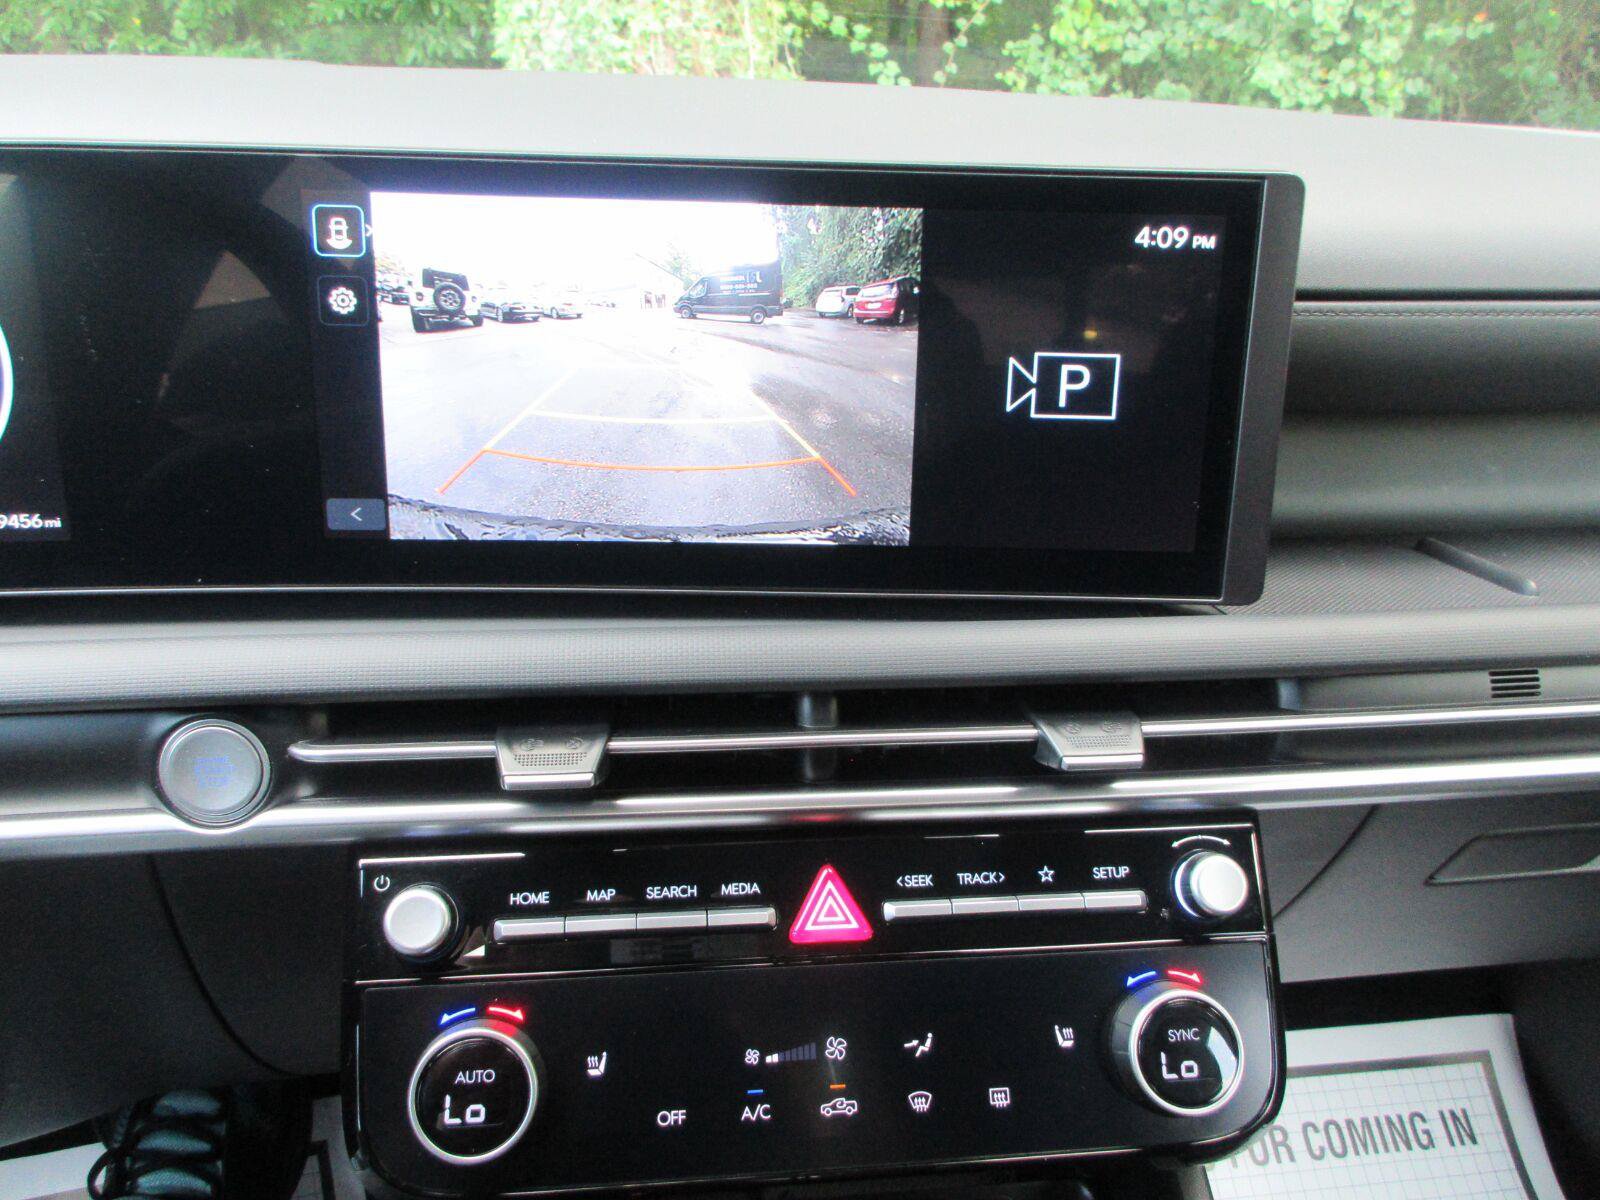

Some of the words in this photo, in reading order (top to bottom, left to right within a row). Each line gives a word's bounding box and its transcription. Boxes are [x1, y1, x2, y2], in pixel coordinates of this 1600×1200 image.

[1135, 225, 1189, 249] 4:09
[1192, 234, 1216, 249] PM
[1059, 364, 1090, 407] P
[44, 518, 61, 528] mi
[1093, 866, 1129, 878] SETUP
[587, 889, 615, 901] MAP
[646, 885, 697, 899] SEARCH
[721, 883, 760, 895] MEDIA
[510, 892, 549, 905] HOME
[1168, 1028, 1199, 1041] SYNC
[455, 1070, 495, 1083] AUTO
[657, 1110, 686, 1126] OFF
[742, 1104, 770, 1121] A/C
[1231, 1124, 1296, 1169] OR
[1302, 1110, 1436, 1161] COMING
[1438, 1107, 1478, 1148] IN
